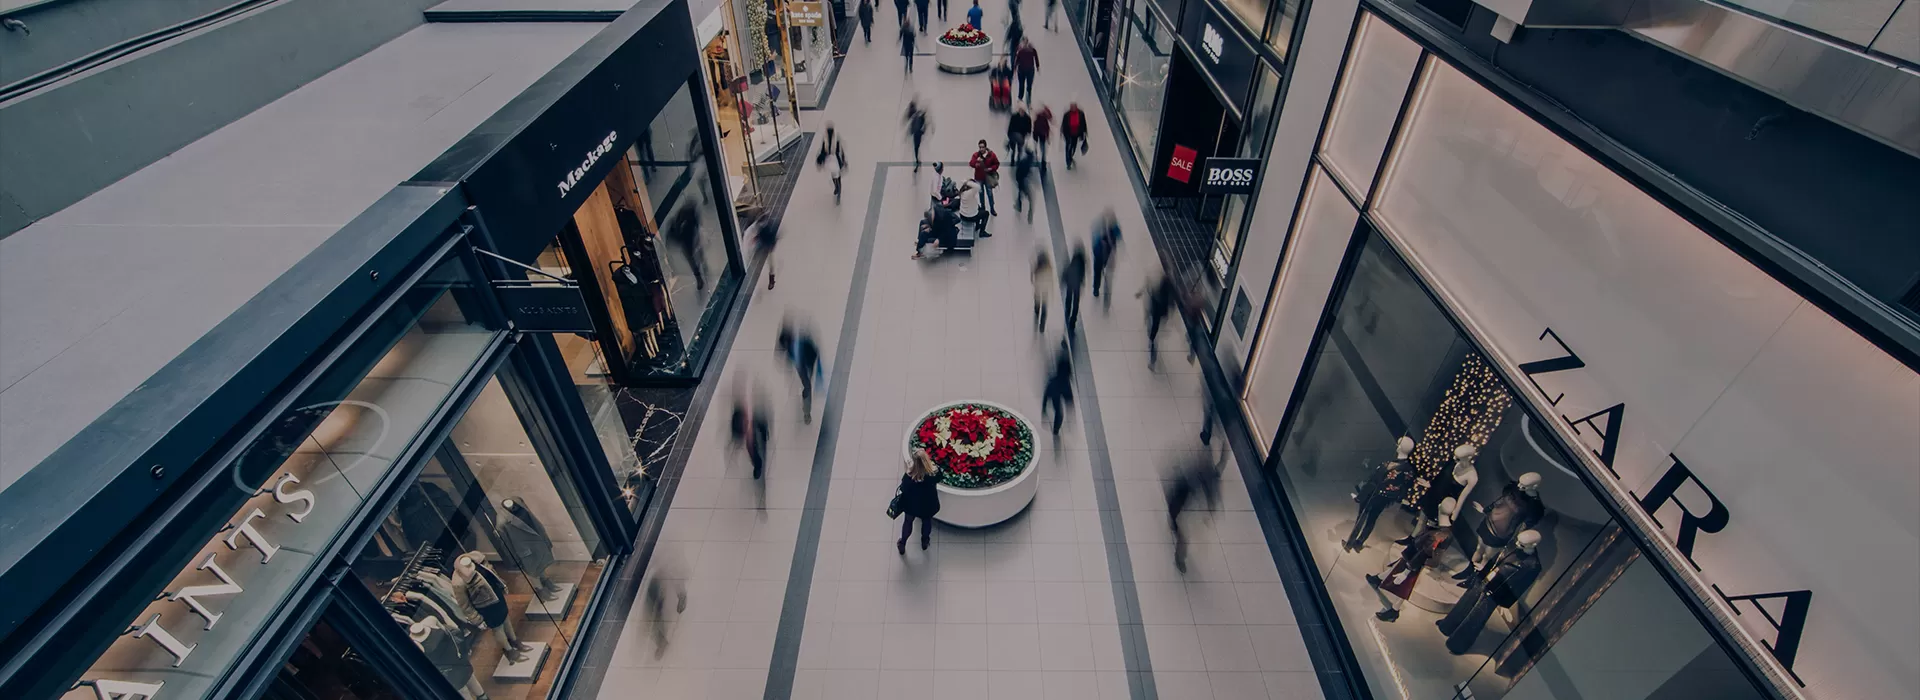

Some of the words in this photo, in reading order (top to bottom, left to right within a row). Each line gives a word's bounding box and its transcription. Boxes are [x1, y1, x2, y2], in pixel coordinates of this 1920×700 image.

[557, 130, 617, 198] Mackage
[1171, 157, 1193, 172] SALE
[1208, 168, 1253, 181] BOSS
[1519, 327, 1812, 688] ZARA
